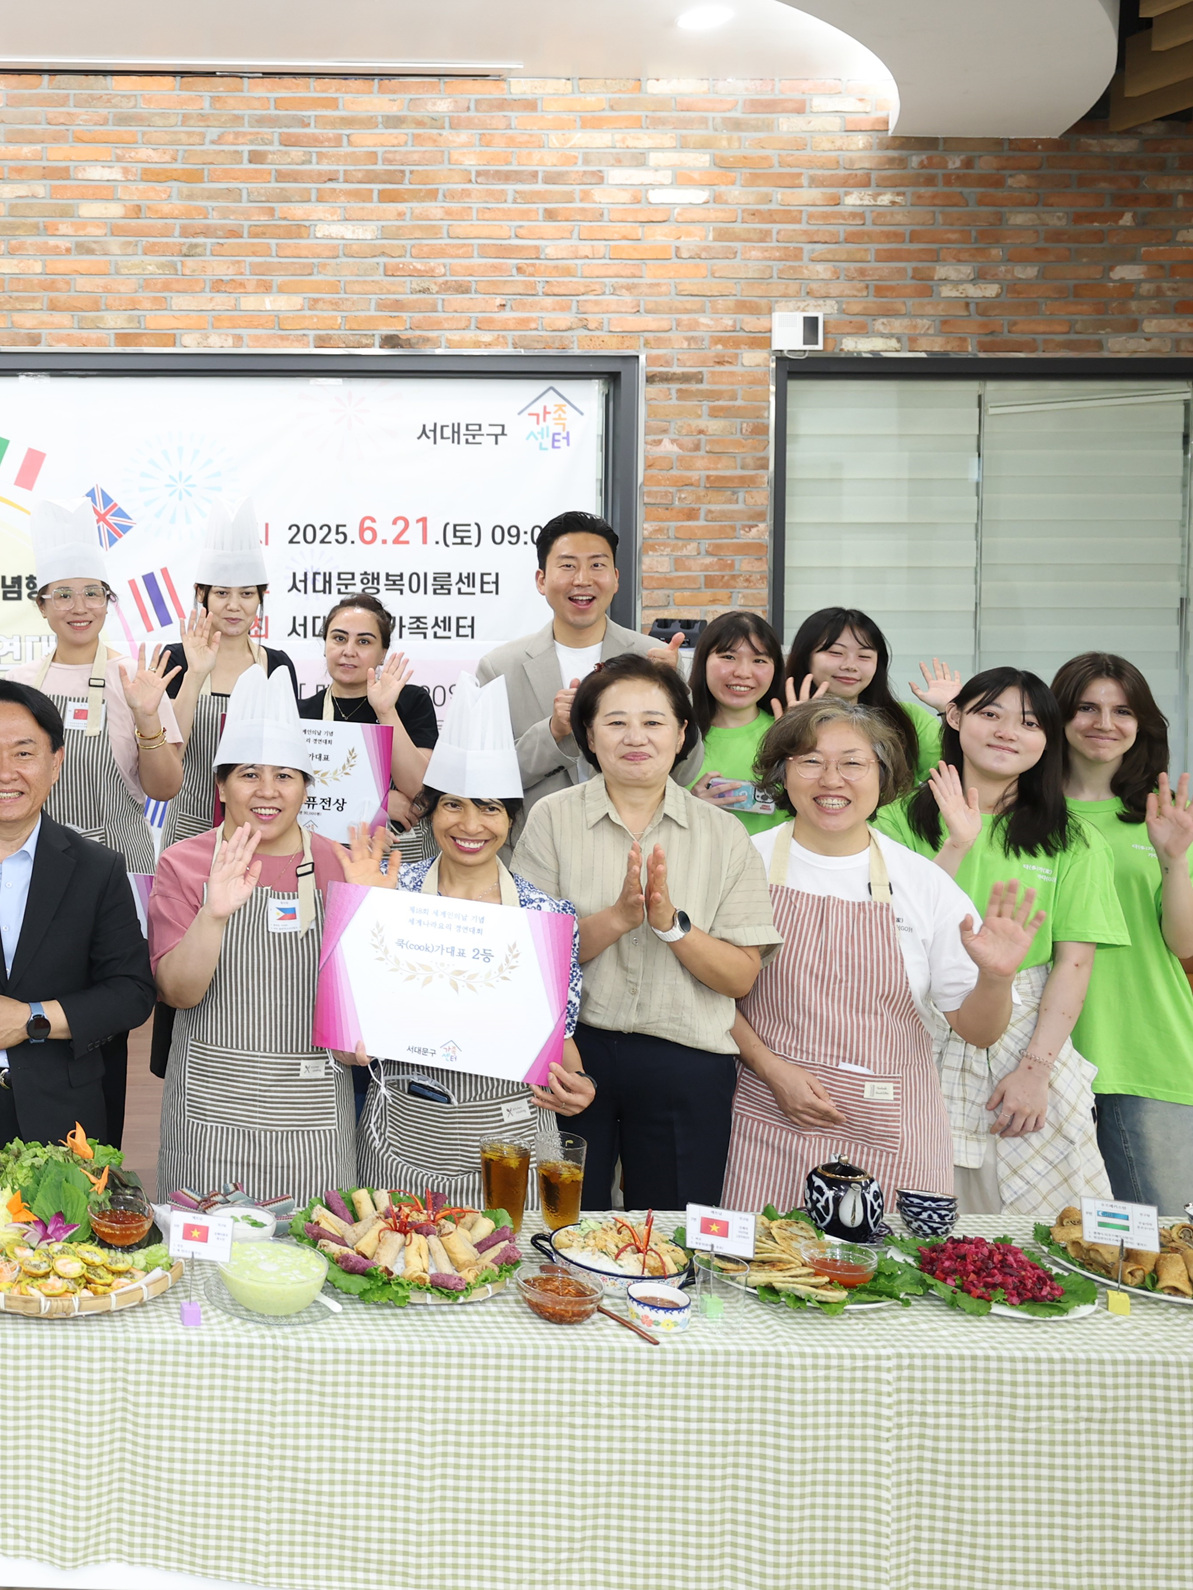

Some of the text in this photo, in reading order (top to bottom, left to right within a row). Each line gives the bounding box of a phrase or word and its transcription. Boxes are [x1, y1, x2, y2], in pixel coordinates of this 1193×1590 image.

[528, 404, 567, 432] 가족
[417, 421, 507, 445] 서대문구
[526, 425, 570, 451] 센터
[287, 515, 482, 547] 2025.6.21.(토)
[492, 524, 543, 546] 09:0
[287, 570, 500, 596] 서대문행복이룸센터
[395, 938, 494, 963] 쿡(cook)가대표 2등
